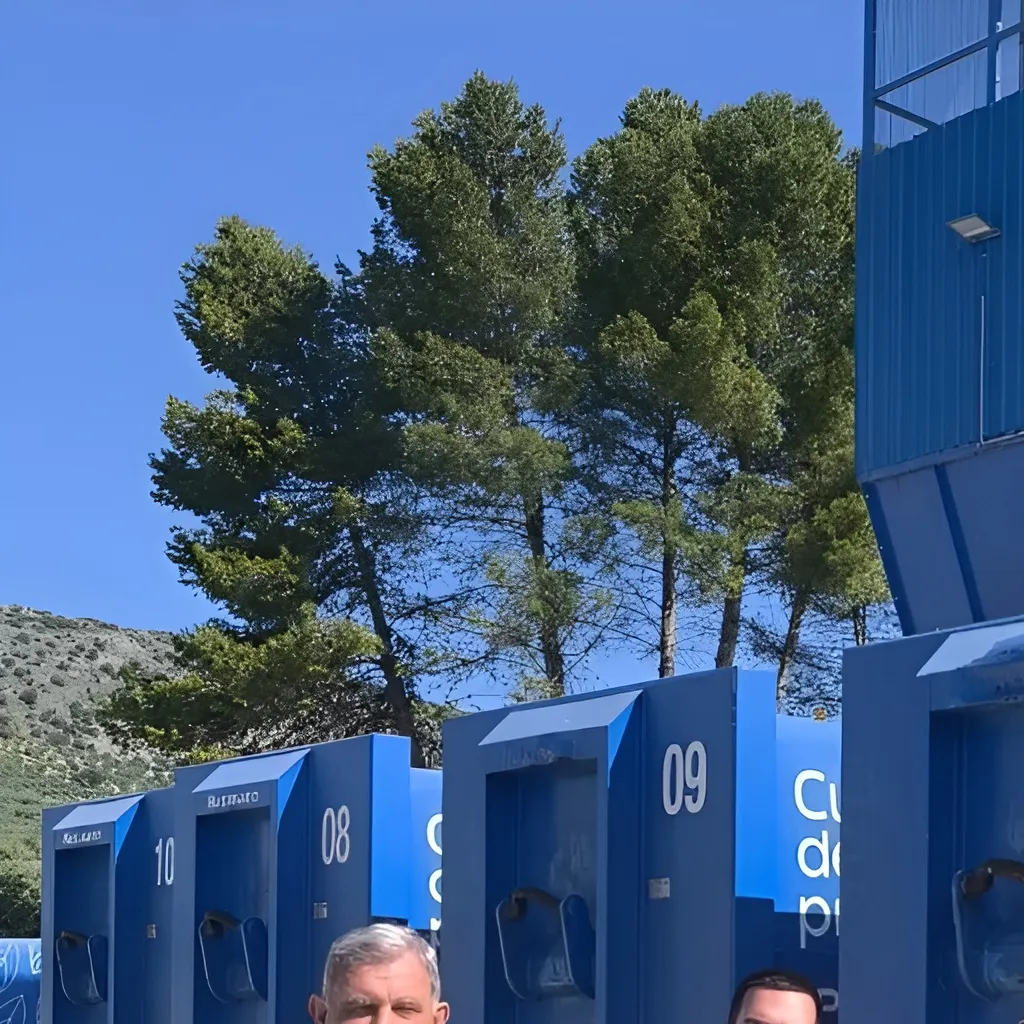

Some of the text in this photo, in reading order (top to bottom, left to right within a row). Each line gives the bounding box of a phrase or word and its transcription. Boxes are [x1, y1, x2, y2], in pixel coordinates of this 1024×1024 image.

[662, 740, 708, 816] 09
[154, 836, 175, 886] 10
[321, 804, 351, 865] 08
